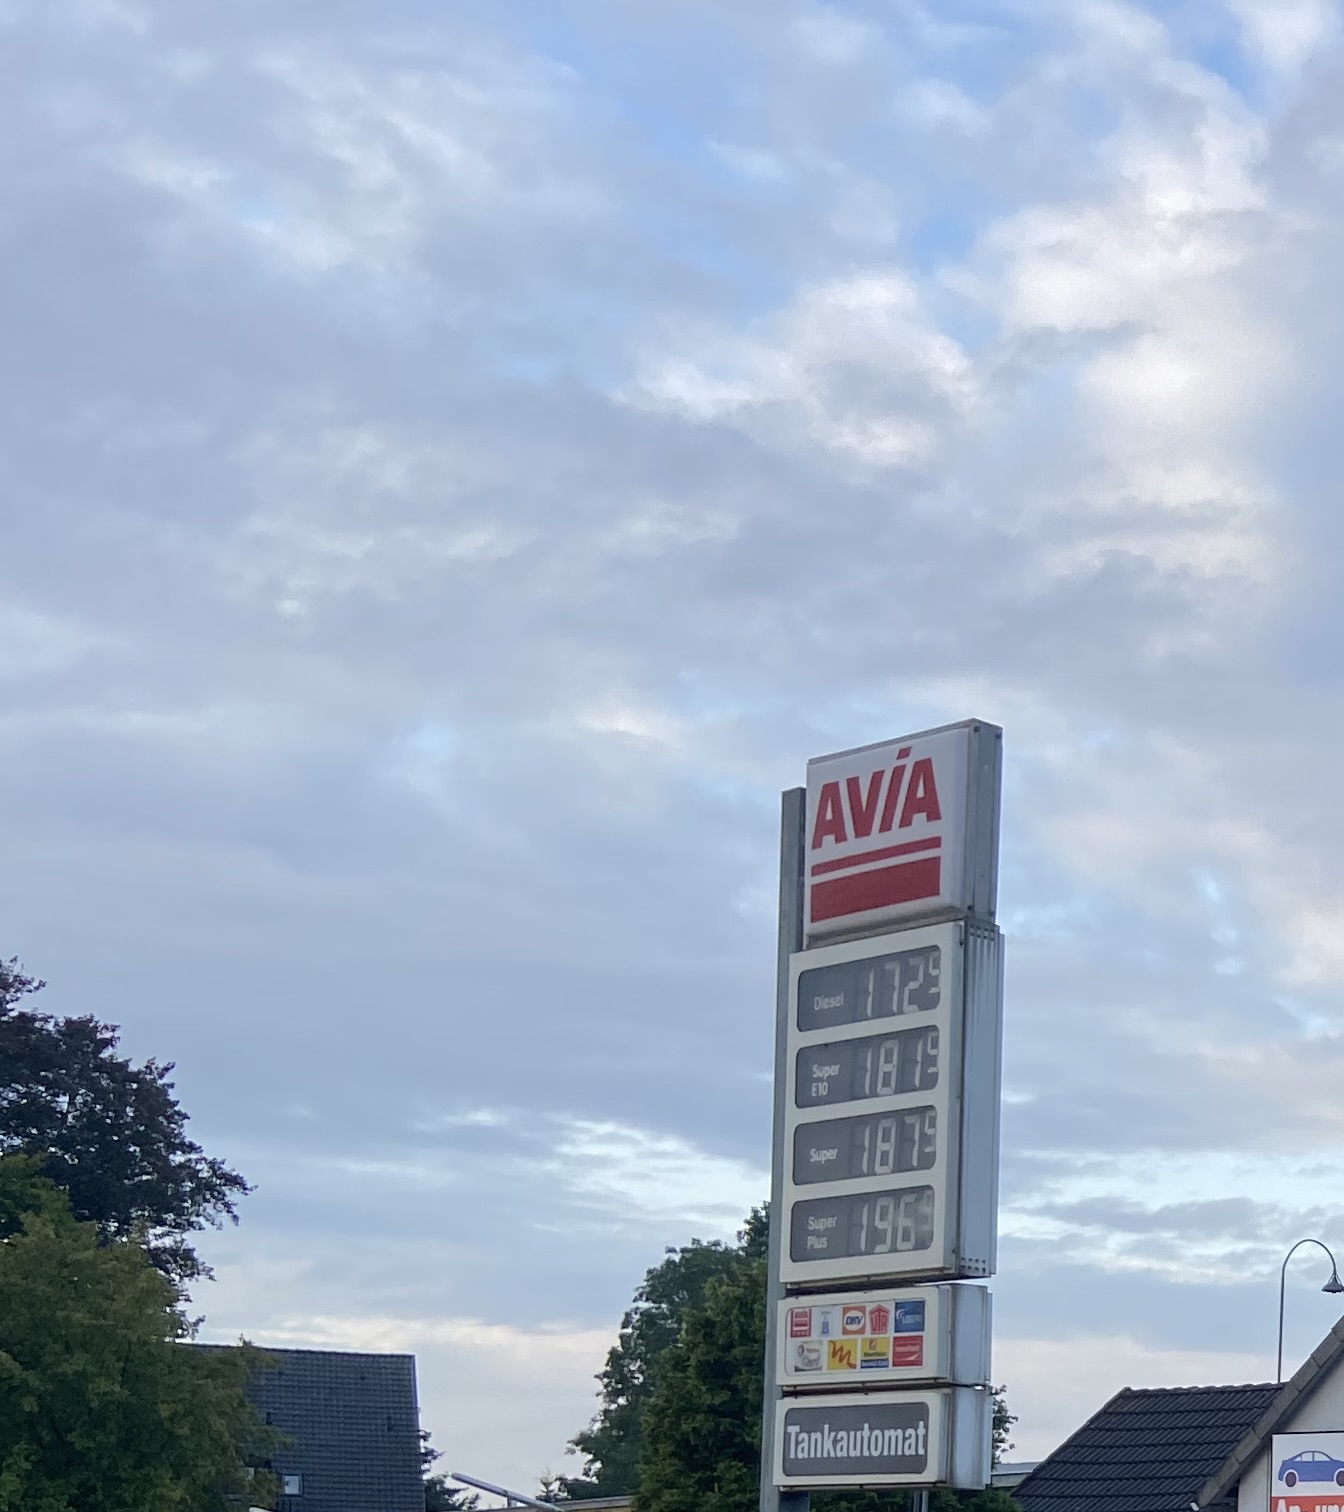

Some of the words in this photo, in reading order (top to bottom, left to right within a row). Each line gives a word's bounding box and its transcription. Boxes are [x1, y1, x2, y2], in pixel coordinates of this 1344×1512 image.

[813, 990, 845, 1011] Diesel
[812, 1063, 840, 1081] Super
[811, 1081, 828, 1096] E10
[810, 1147, 838, 1164] Super
[807, 1213, 838, 1230] Super
[807, 1232, 828, 1250] Plus
[786, 1420, 927, 1460] Tankautomat
